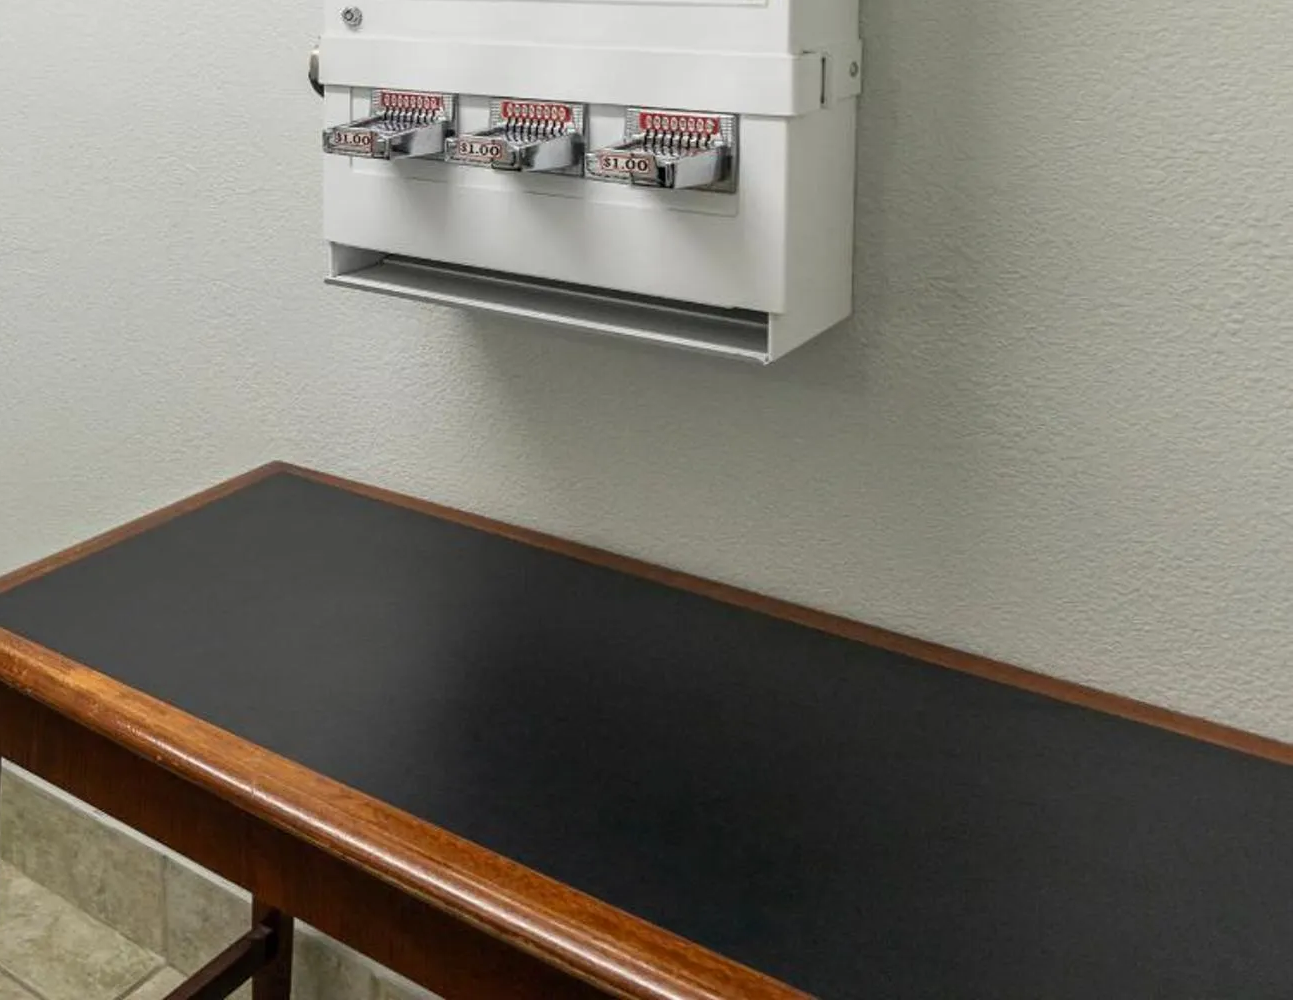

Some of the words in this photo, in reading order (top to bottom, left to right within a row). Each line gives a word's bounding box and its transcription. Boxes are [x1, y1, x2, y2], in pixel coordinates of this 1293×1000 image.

[335, 131, 371, 146] $1.00
[459, 143, 500, 157] $1.00
[602, 157, 649, 172] $1.00
